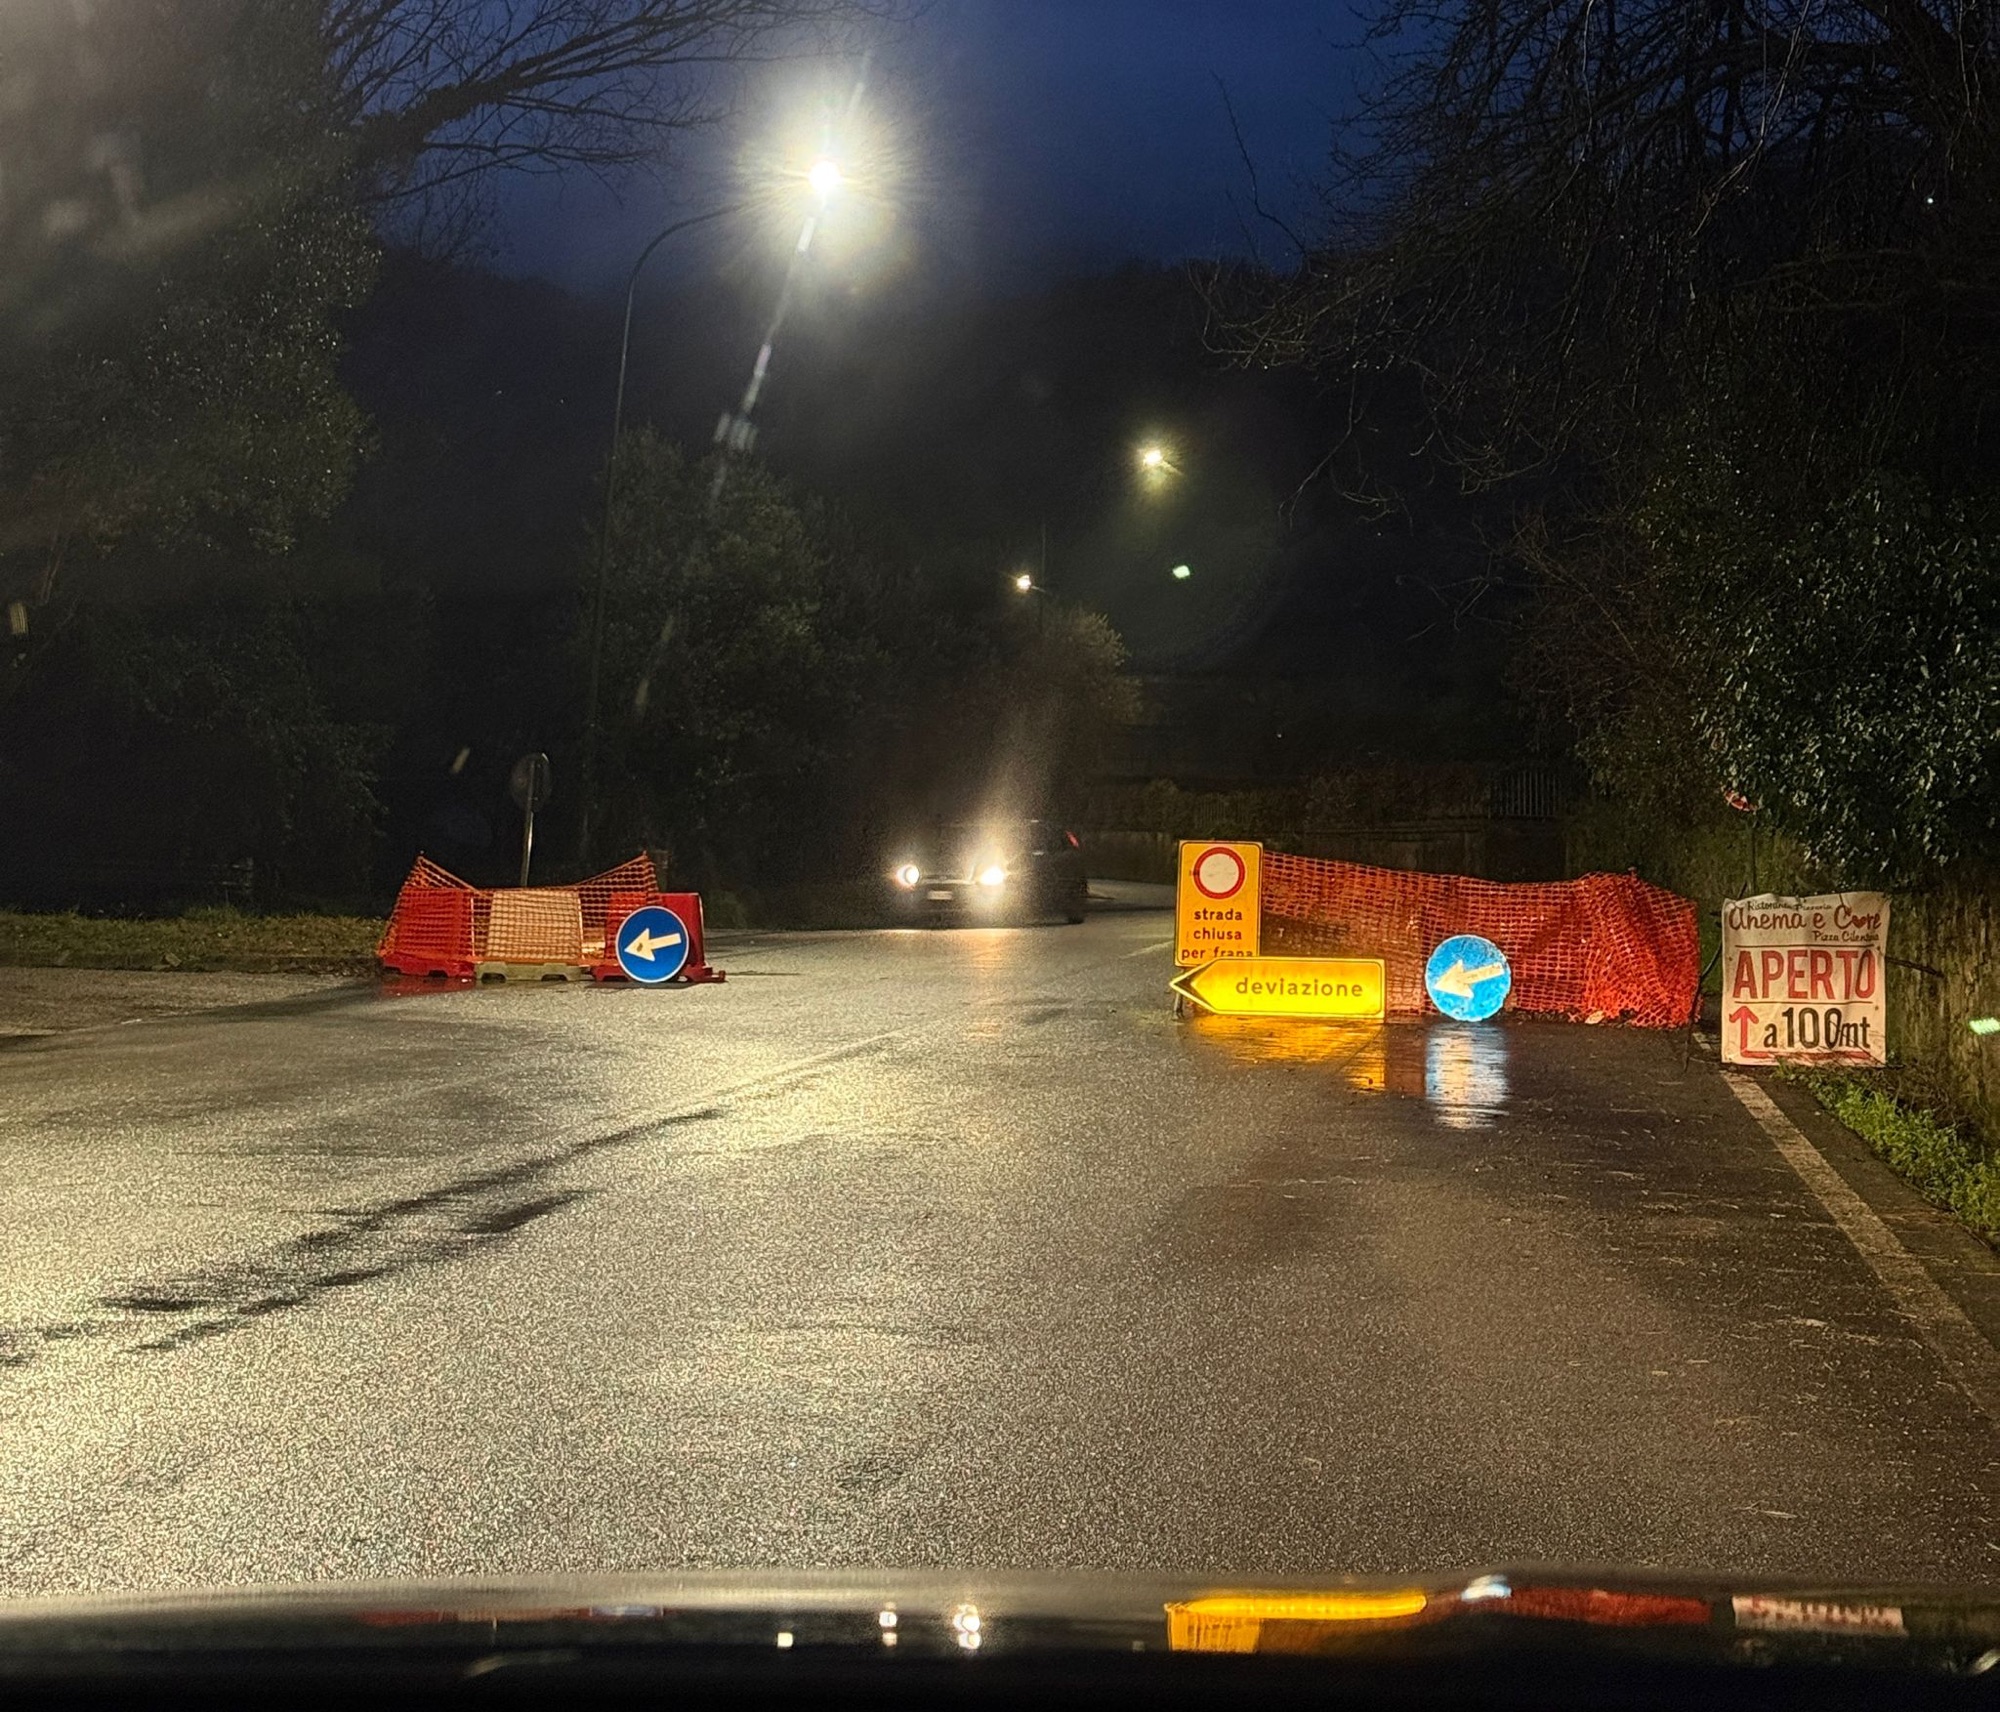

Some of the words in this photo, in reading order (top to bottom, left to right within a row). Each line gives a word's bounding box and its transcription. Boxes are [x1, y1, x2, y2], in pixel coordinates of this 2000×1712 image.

[1194, 908, 1243, 920] strada
[1813, 912, 1827, 930] e
[1193, 927, 1242, 940] chiusa
[1813, 930, 1839, 942] Pizza
[1181, 949, 1206, 960] per
[1732, 949, 1876, 1000] APERTO
[1235, 977, 1364, 997] deviazione
